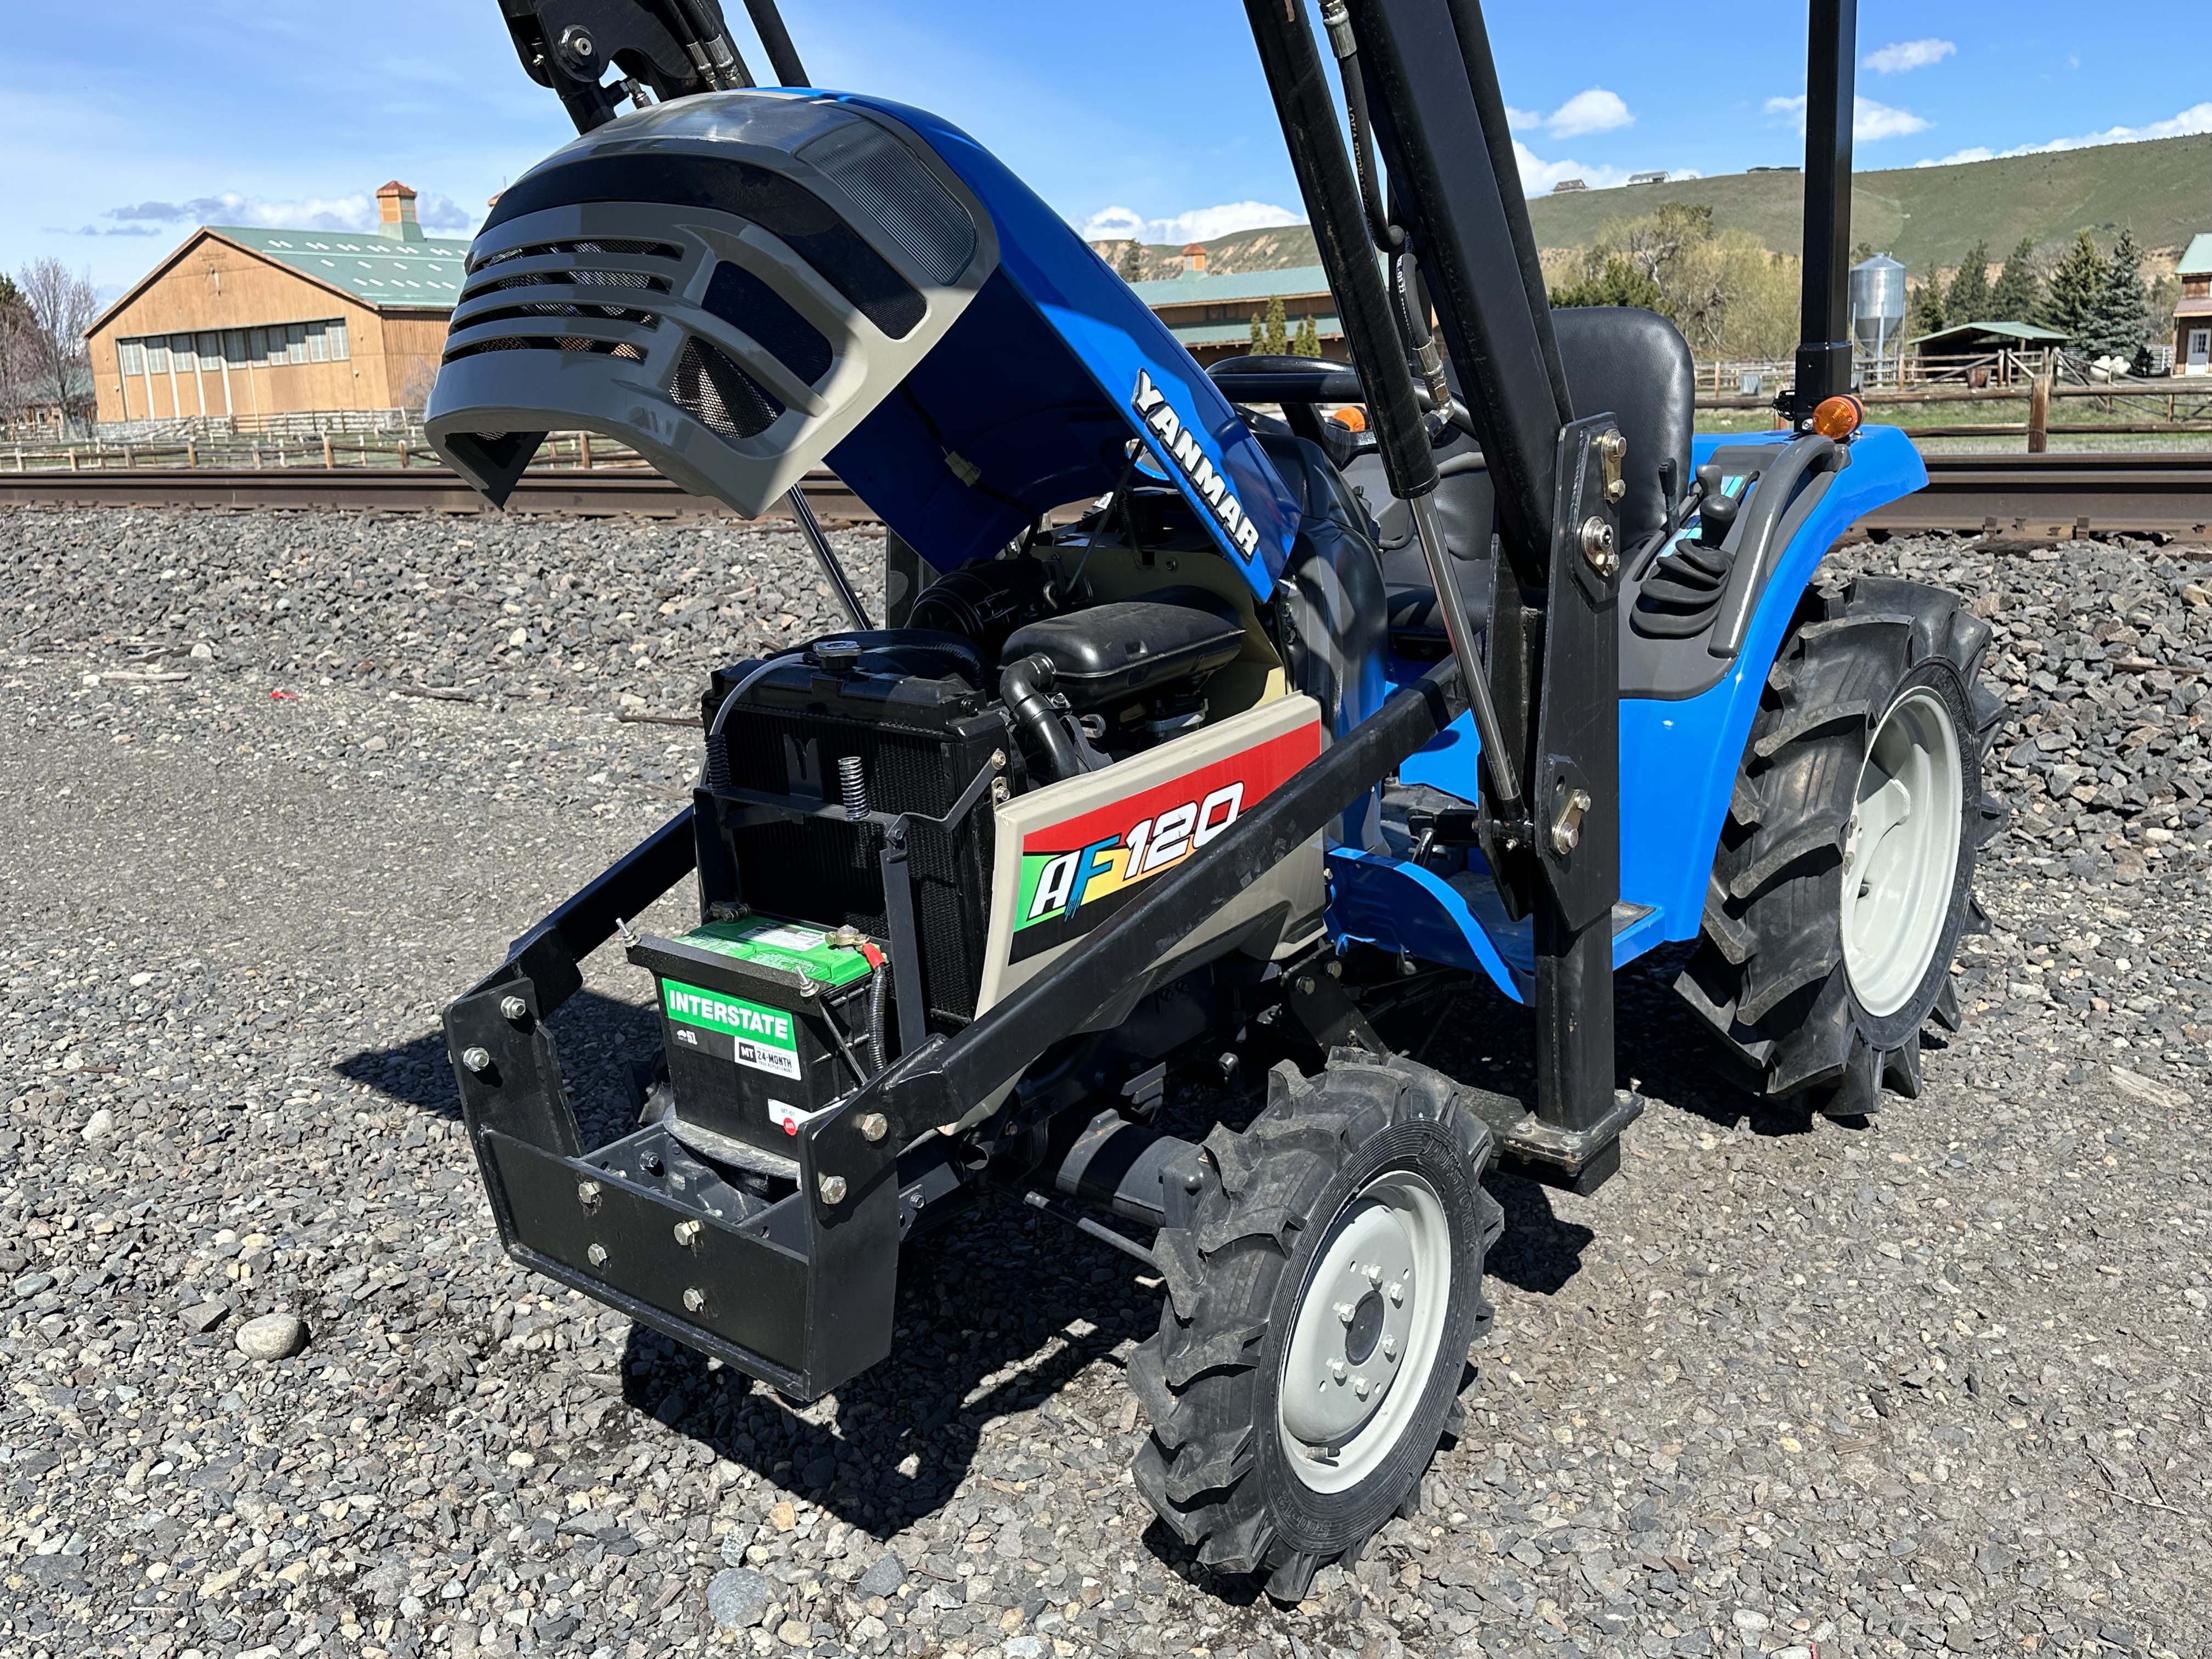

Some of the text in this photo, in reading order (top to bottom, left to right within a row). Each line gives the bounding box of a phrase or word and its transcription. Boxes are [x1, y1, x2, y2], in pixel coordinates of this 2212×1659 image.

[1133, 369, 1260, 561] YANMAR
[1026, 781, 1244, 921] AF120
[669, 990, 788, 1040] INTERSTATE
[741, 1046, 754, 1059] MT
[757, 1050, 792, 1068] 24-MONTH
